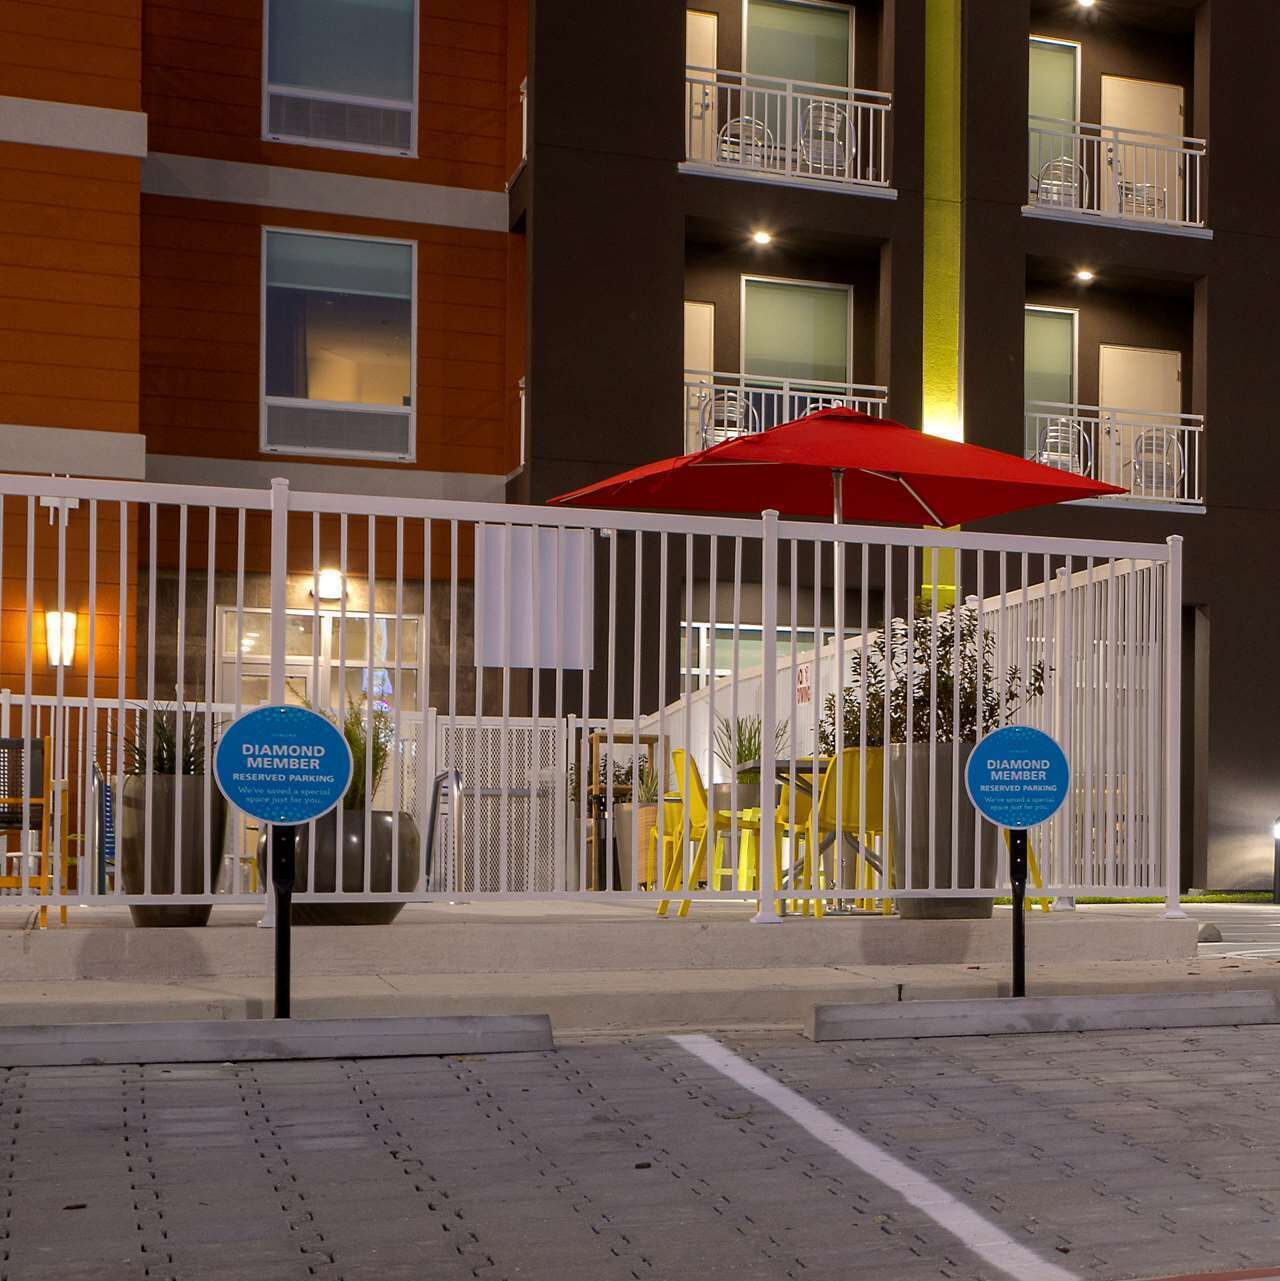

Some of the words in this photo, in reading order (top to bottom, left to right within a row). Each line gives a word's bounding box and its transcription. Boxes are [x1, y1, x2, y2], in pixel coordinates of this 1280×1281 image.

[242, 744, 326, 757] DIAMOND
[247, 757, 320, 770] MEMBER
[987, 760, 1050, 769] DIAMOND
[232, 772, 286, 782] RESERVED
[289, 774, 335, 783] PARKING
[991, 771, 1047, 780] MEMBER
[301, 787, 331, 797] special
